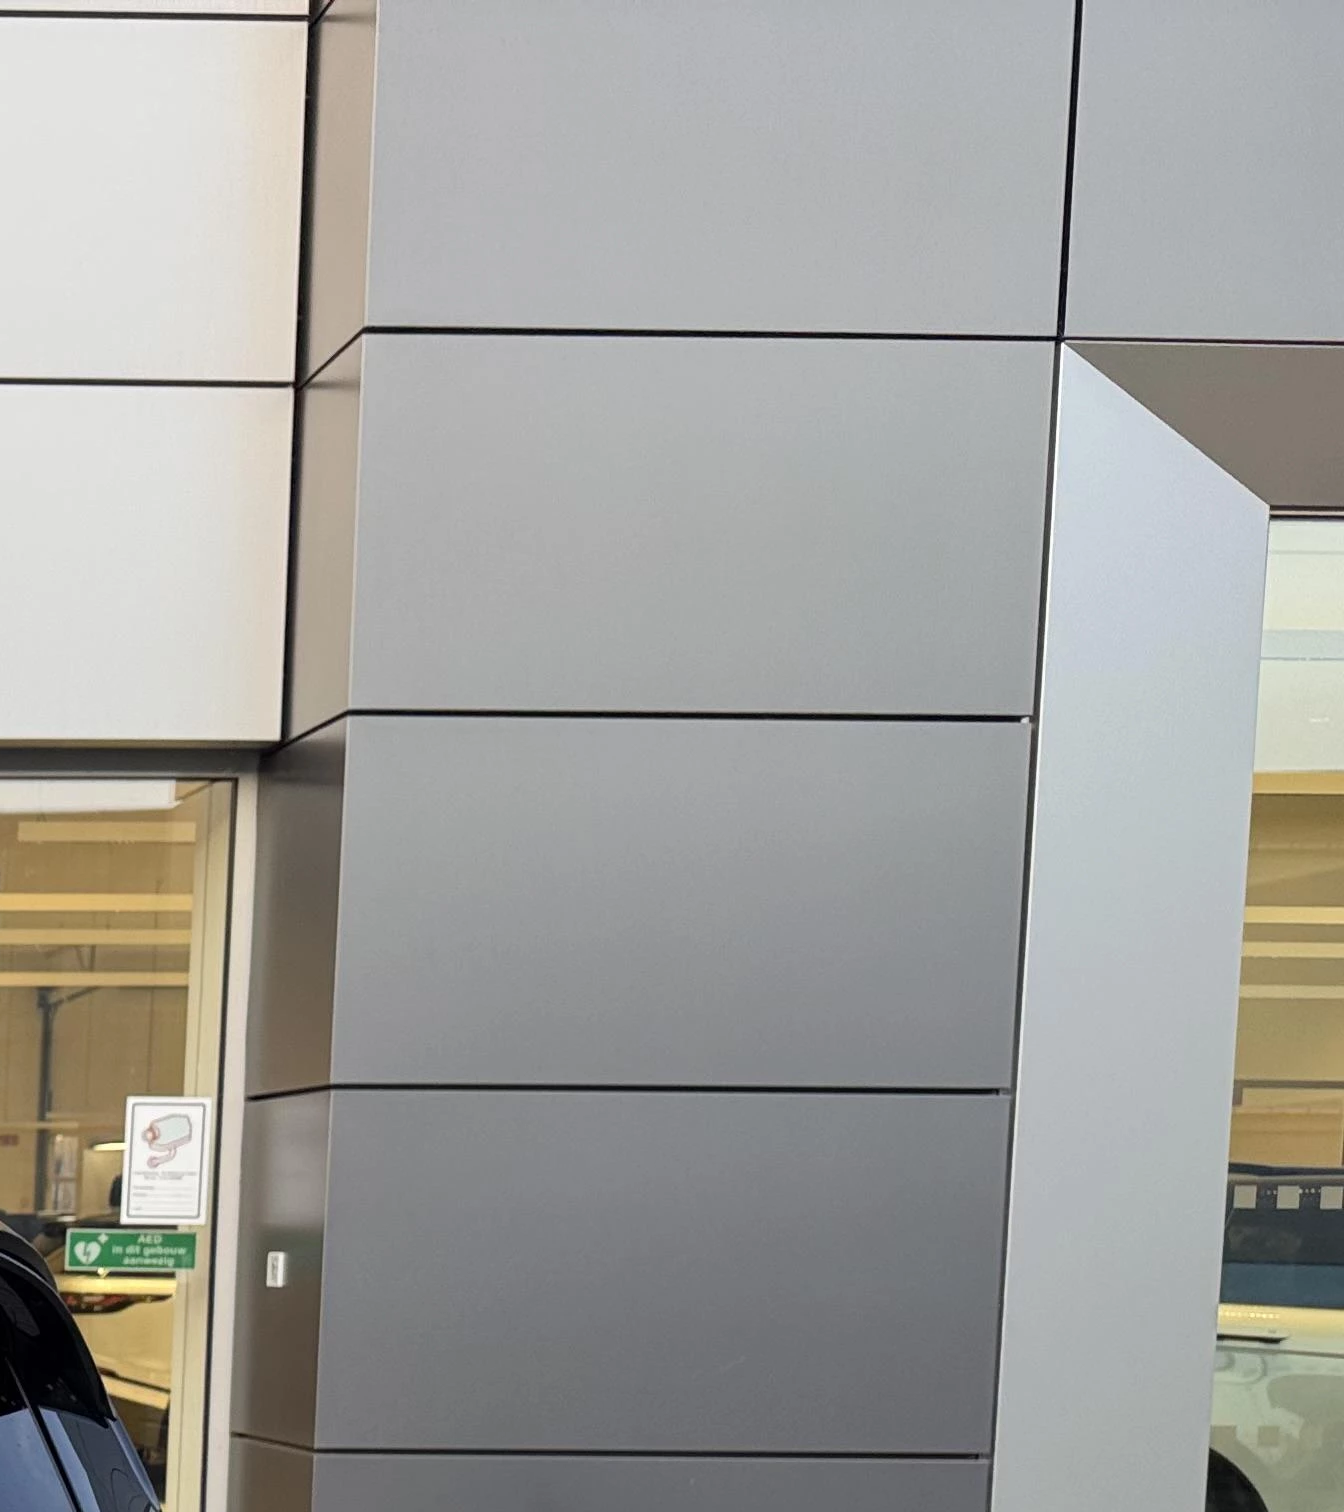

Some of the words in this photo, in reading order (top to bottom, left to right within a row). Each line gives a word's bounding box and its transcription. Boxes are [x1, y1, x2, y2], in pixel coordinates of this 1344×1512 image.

[137, 1234, 164, 1244] AED
[112, 1245, 124, 1255] in
[125, 1244, 141, 1255] dit
[142, 1245, 187, 1257] gebouw
[122, 1256, 175, 1267] aanwezig
